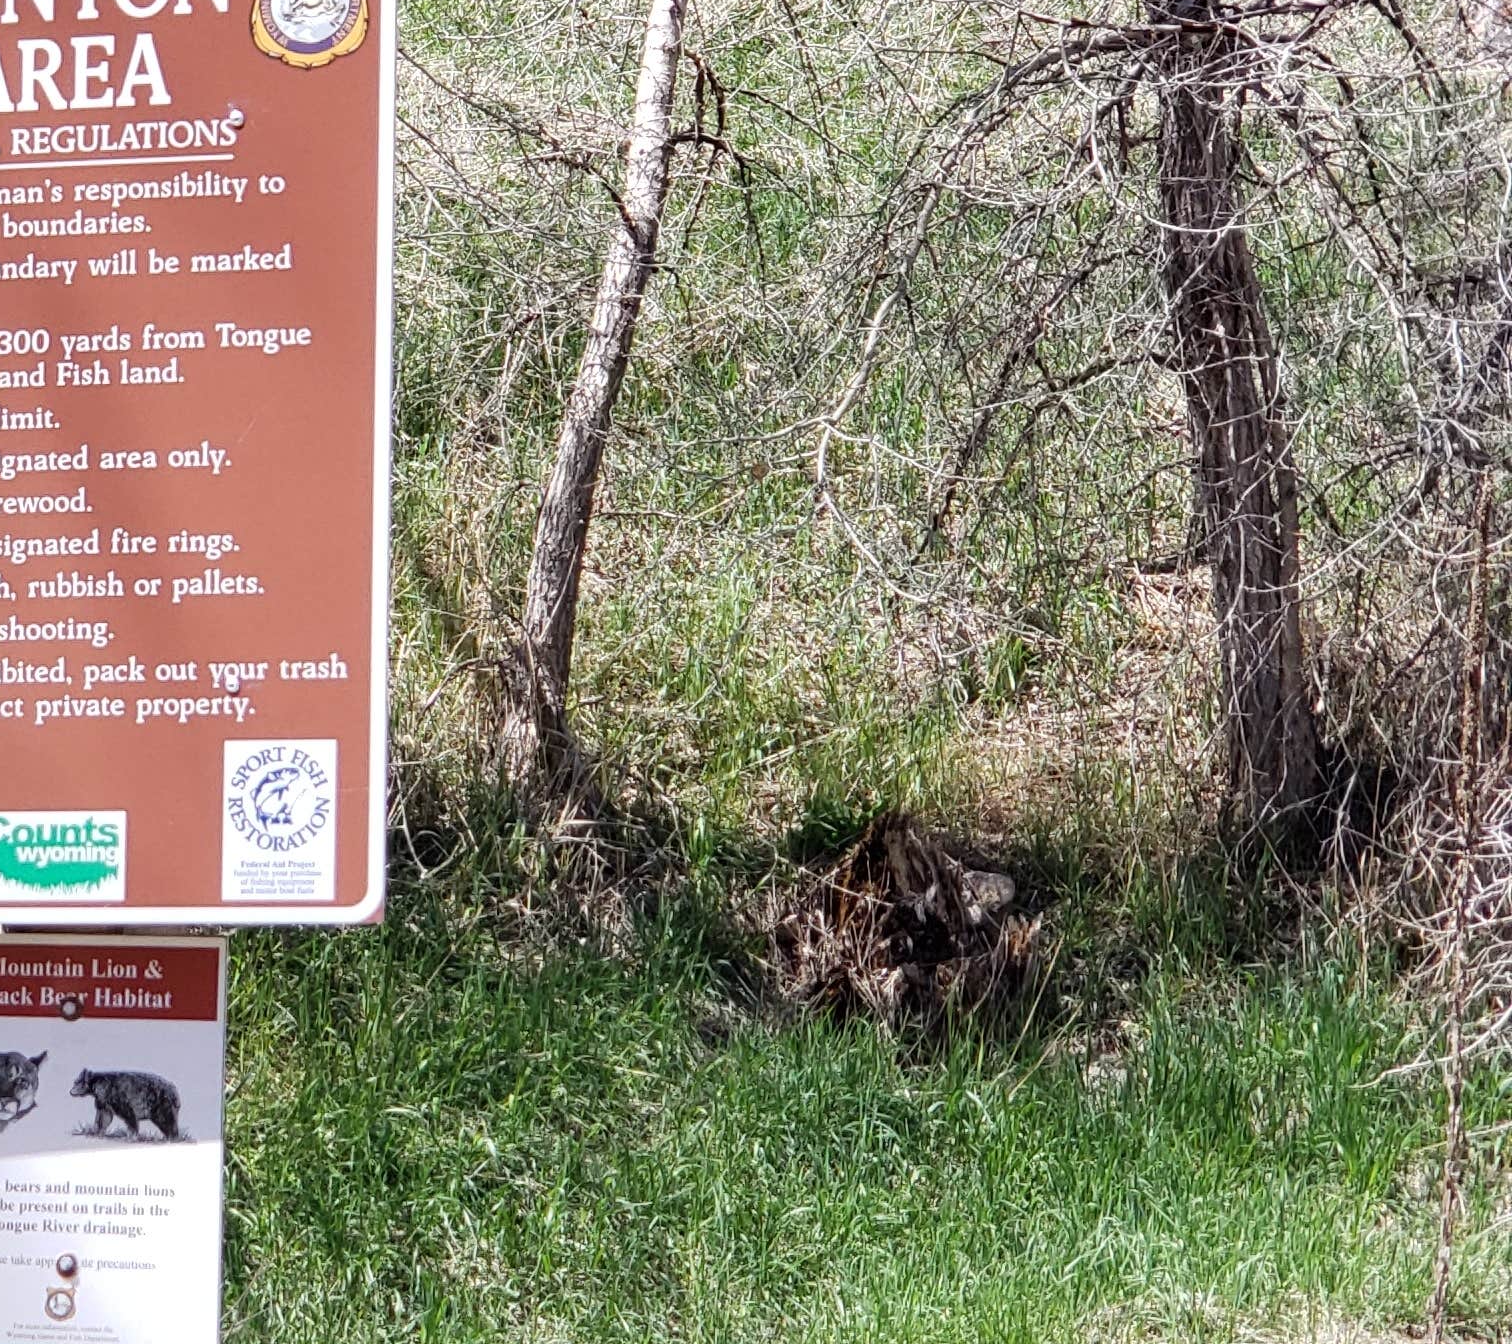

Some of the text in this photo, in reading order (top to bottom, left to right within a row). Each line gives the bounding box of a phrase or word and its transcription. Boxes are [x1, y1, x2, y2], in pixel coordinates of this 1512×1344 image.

[10, 119, 237, 155] REGULATIONS
[74, 171, 248, 207] responsibility
[259, 175, 285, 194] to
[3, 209, 151, 237] boundaries.
[88, 249, 136, 276] will
[148, 248, 179, 274] be
[190, 244, 292, 272] marked
[60, 325, 131, 359] yards
[142, 323, 205, 350] from
[215, 323, 311, 354] Tongue
[56, 359, 110, 387] Fish
[120, 357, 185, 384] land.
[99, 450, 157, 470] area
[168, 441, 231, 474] only.
[110, 527, 157, 554] fire
[168, 529, 240, 561] rings.
[27, 570, 125, 599] rubbish
[134, 578, 162, 596] or
[172, 568, 265, 603] pallets.
[83, 656, 146, 691] pack
[155, 661, 198, 681] out
[208, 662, 269, 689] your
[279, 652, 348, 680] trash
[35, 694, 125, 725] private
[136, 695, 256, 724] property.
[231, 746, 329, 790] SPORT FISH
[228, 796, 331, 852] RESTORATION
[16, 844, 118, 868] wyoming
[91, 958, 138, 979] Lion
[144, 959, 164, 979] &
[94, 986, 173, 1009] Habitat
[5, 1179, 41, 1194] bears
[45, 1181, 70, 1195] and
[75, 1183, 139, 1196] mountain
[144, 1184, 175, 1197] lions
[0, 1198, 15, 1212] be
[19, 1201, 68, 1214] present
[72, 1204, 88, 1215] on
[93, 1202, 128, 1216] trails
[132, 1203, 145, 1216] in
[150, 1204, 170, 1217] the
[42, 1219, 80, 1234] River
[83, 1220, 146, 1238] drainage.
